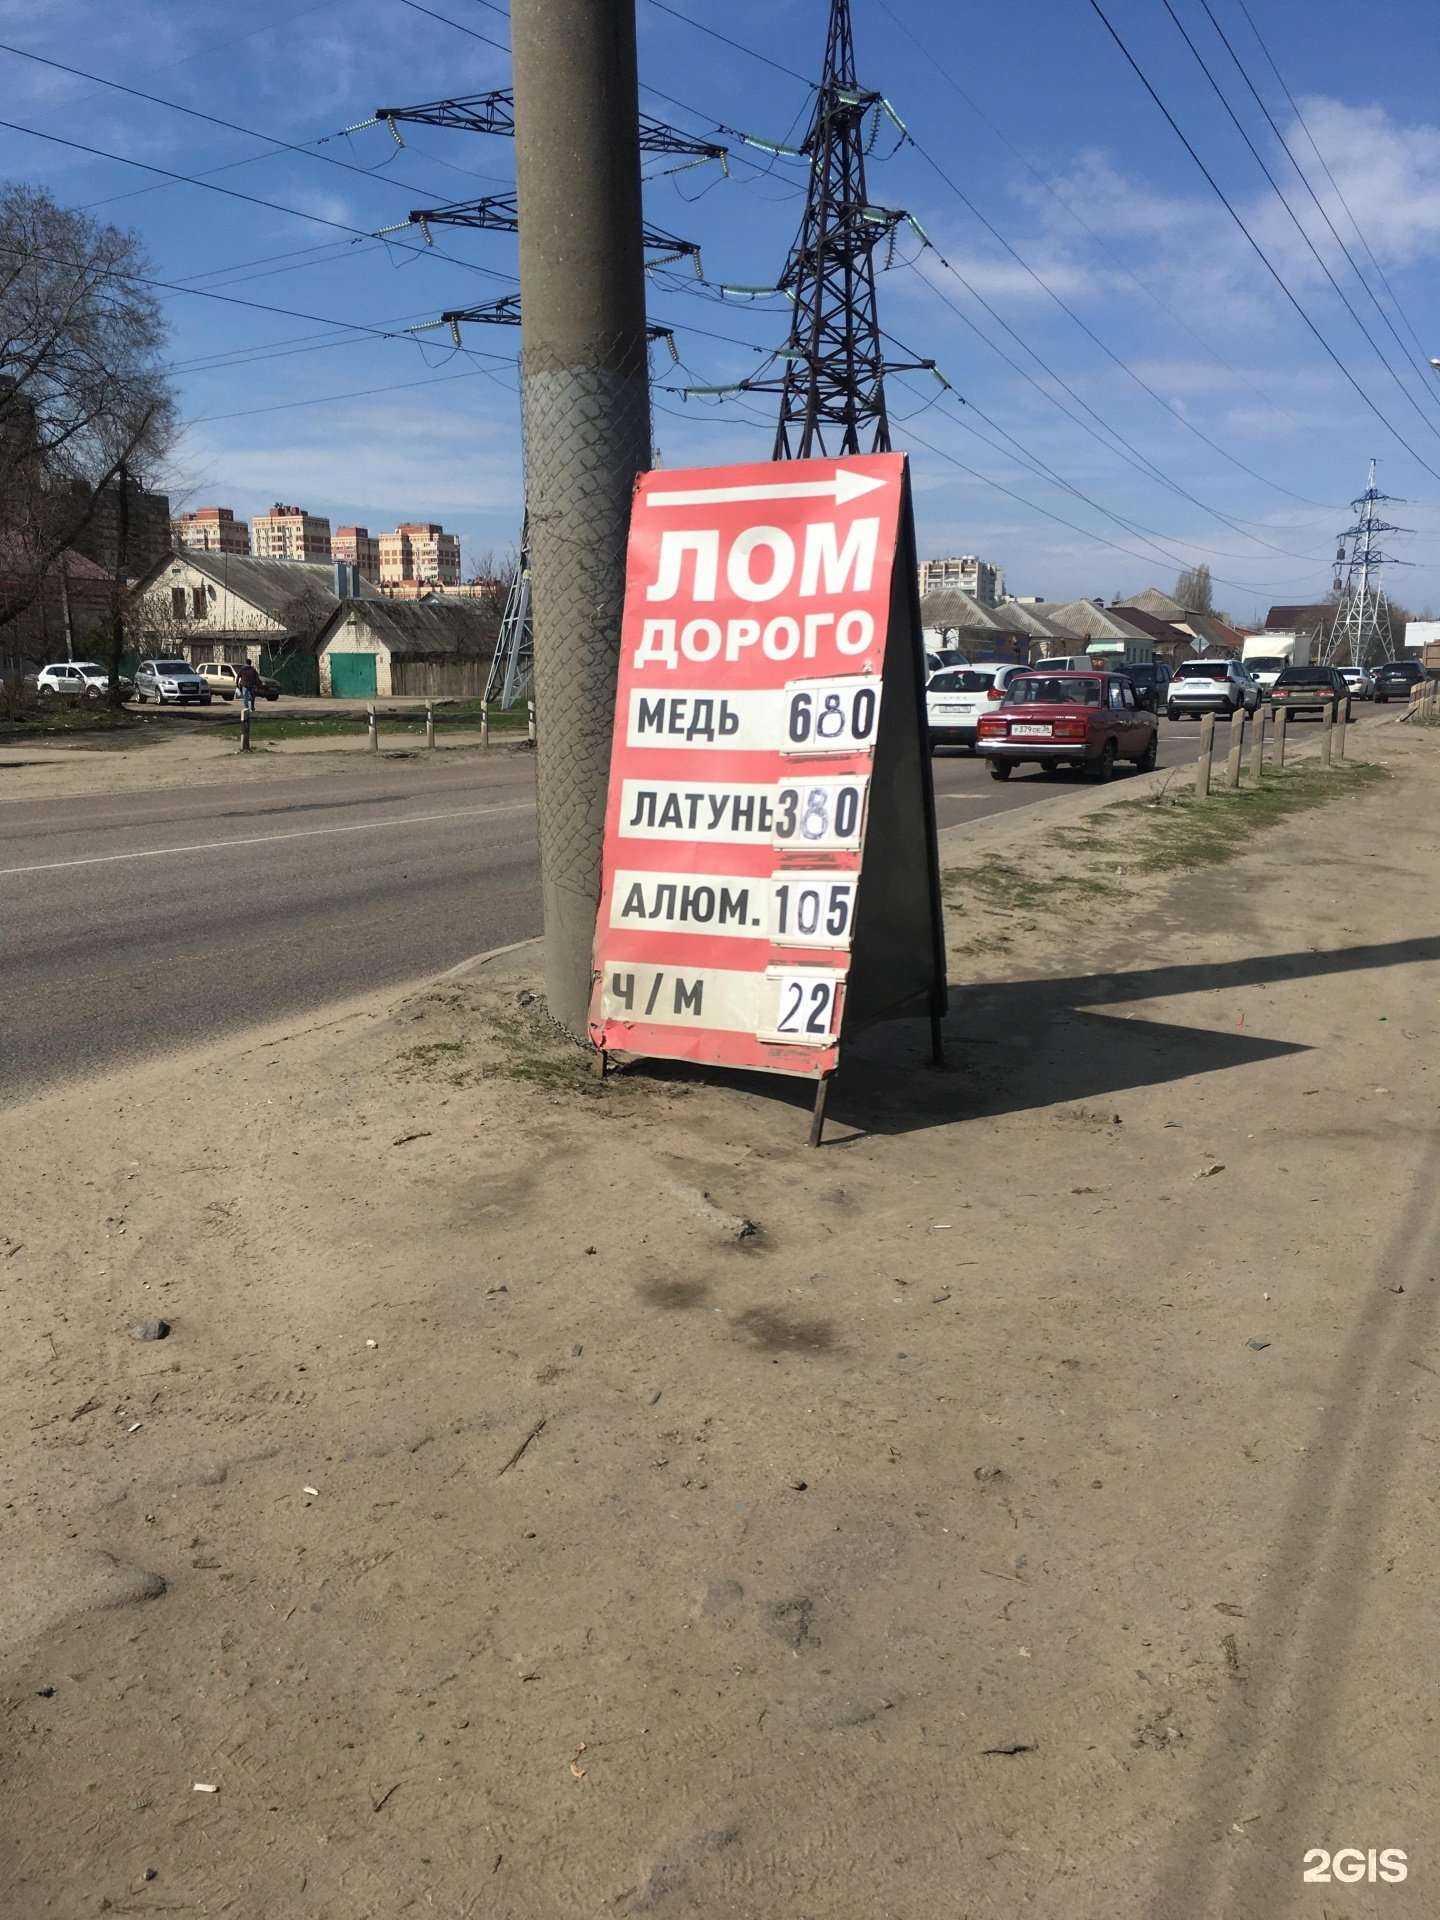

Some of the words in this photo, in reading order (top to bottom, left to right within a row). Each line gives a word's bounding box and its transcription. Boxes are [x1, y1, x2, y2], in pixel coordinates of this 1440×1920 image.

[646, 517, 880, 603] ЛОМ
[633, 610, 875, 670] ДОРОГО
[637, 697, 740, 742] МЕДЬ
[789, 688, 876, 743] 680
[630, 791, 773, 832] ЛАТУНЬ
[776, 787, 859, 840] 380
[621, 882, 761, 927] АЛЮМ.
[775, 885, 851, 936] 105
[777, 982, 831, 1034] 22
